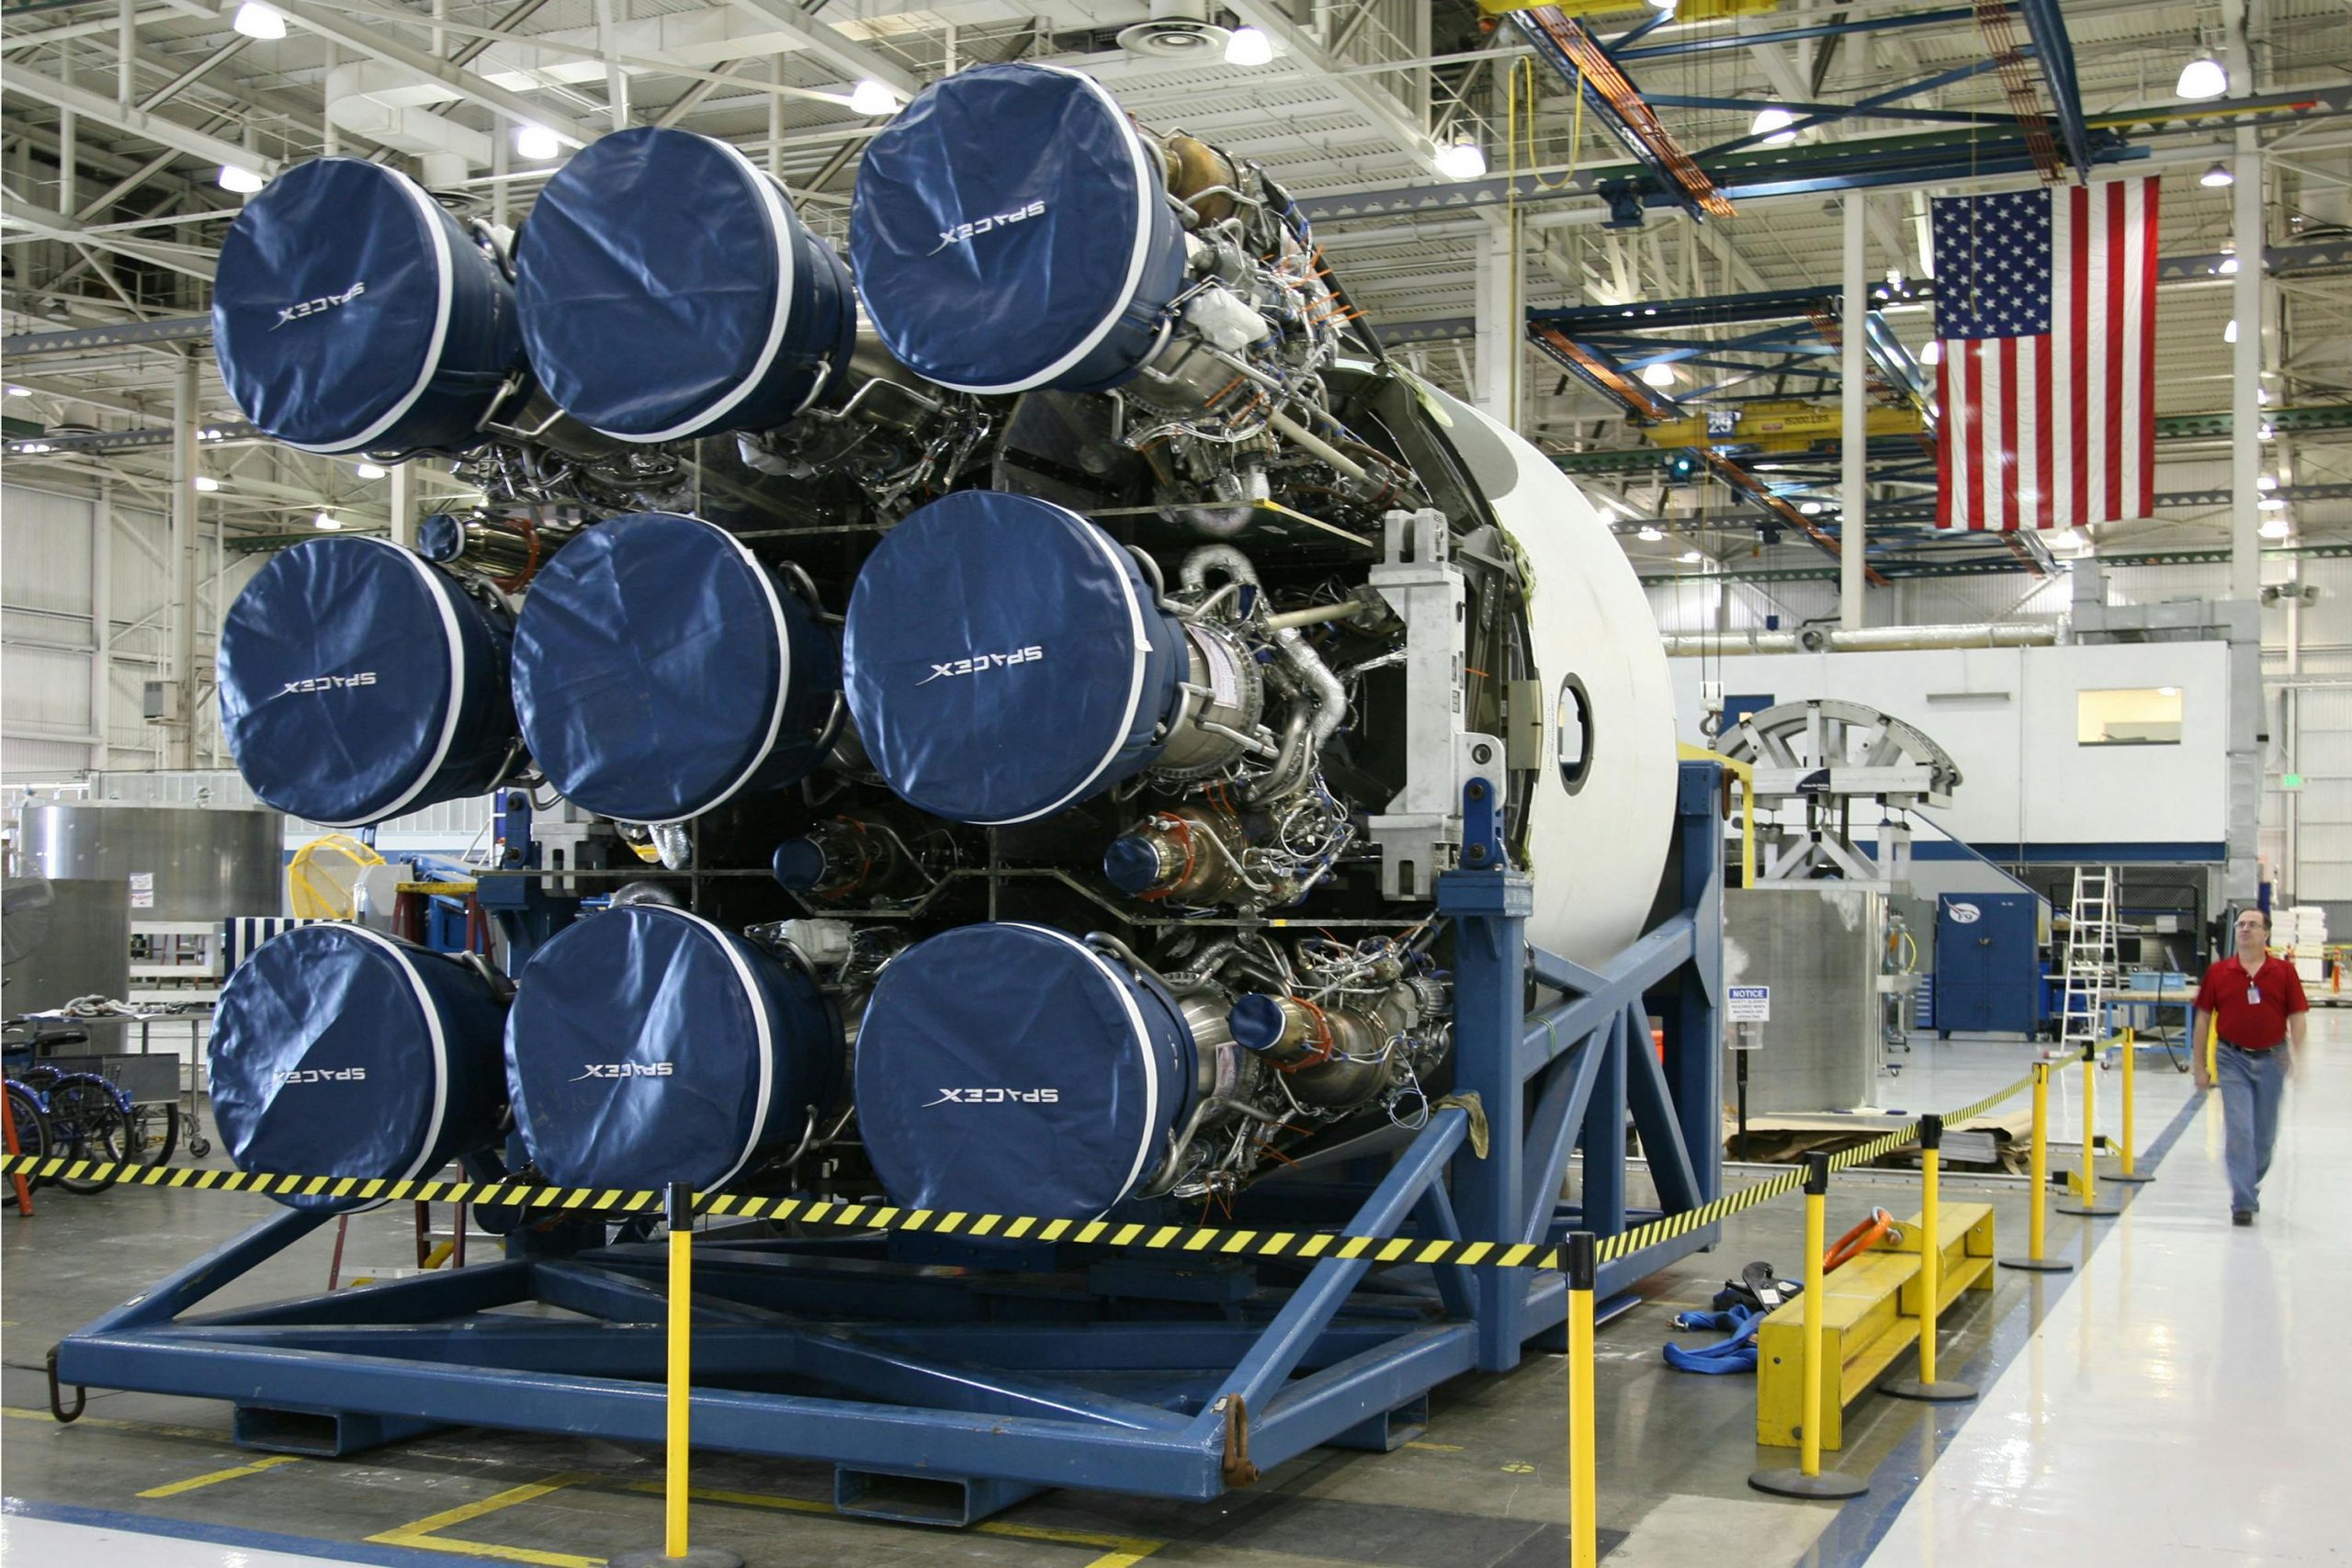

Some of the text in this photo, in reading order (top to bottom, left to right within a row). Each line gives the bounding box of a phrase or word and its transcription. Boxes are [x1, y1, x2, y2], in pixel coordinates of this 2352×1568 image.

[926, 200, 1046, 256] SPACEX
[268, 282, 365, 332] SPACEX
[915, 645, 1044, 686] SPACEX
[267, 671, 377, 700] SPACEX
[1733, 989, 1764, 998] NOTICE
[568, 1062, 673, 1082] SPACEX
[922, 1089, 1058, 1108] SPACEX
